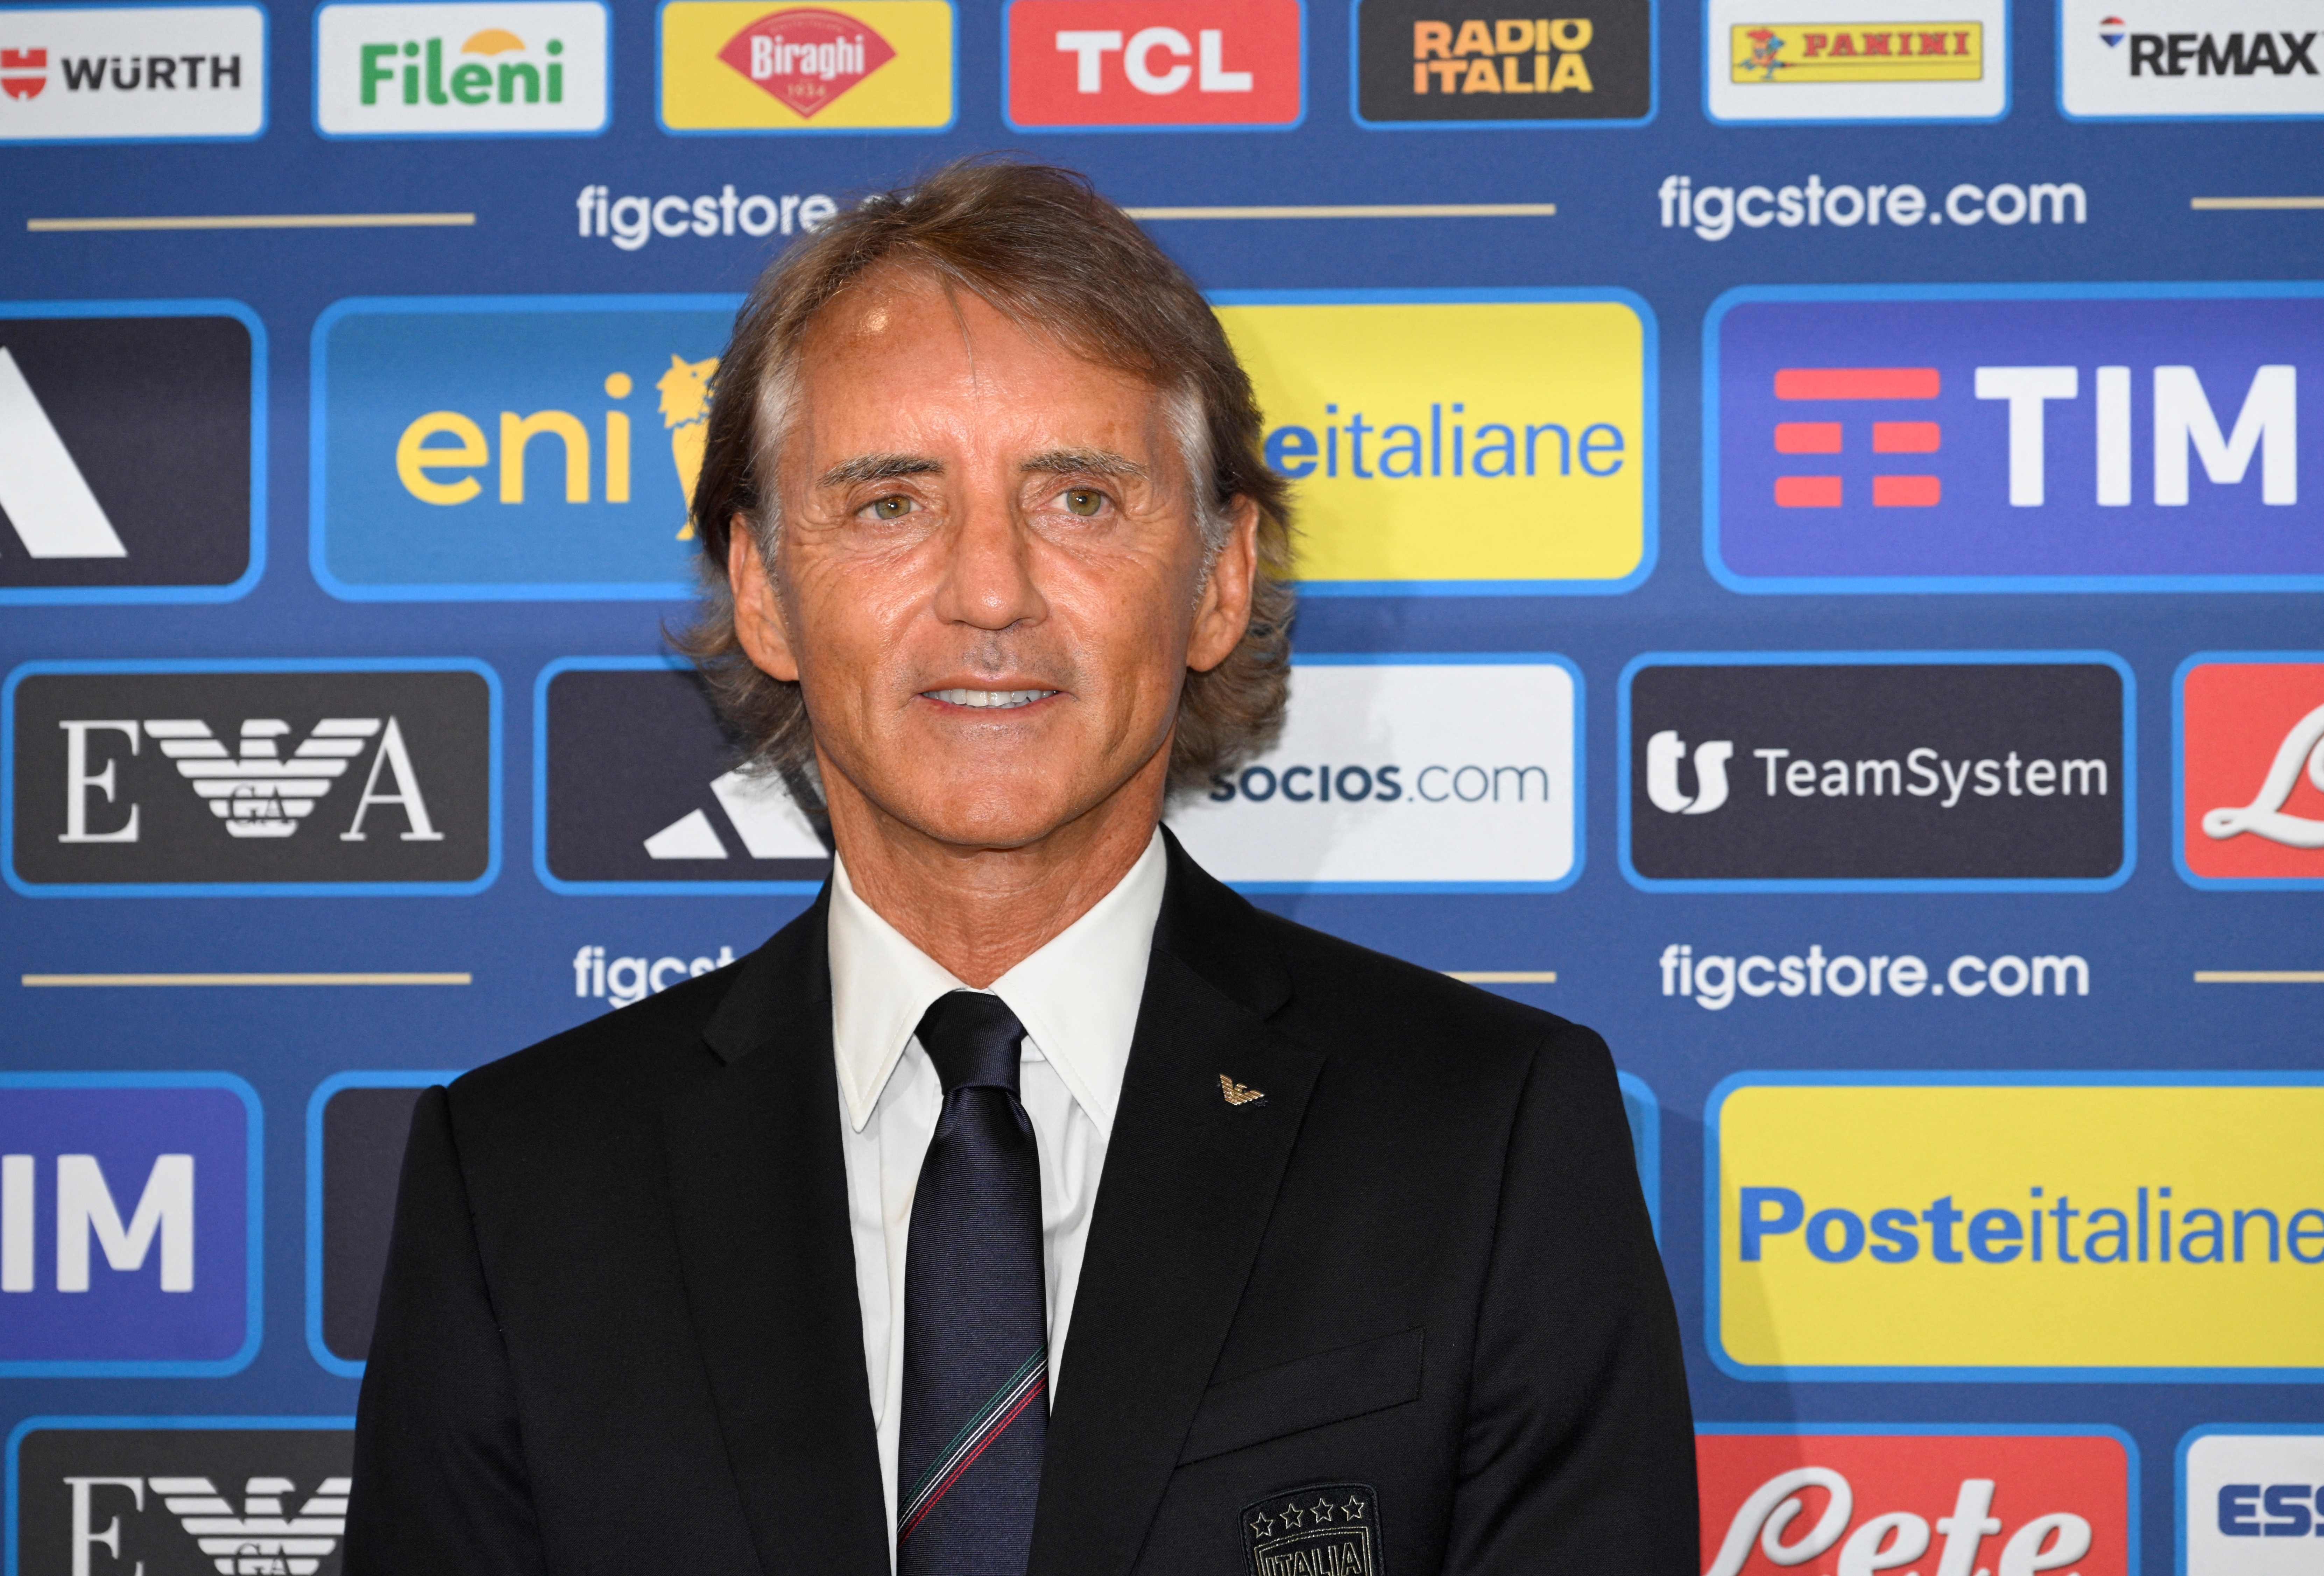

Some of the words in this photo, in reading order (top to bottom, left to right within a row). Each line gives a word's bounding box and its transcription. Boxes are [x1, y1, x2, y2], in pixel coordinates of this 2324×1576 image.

[750, 34, 865, 80] Biraghi
[1056, 27, 1253, 95] TCL
[1413, 18, 1594, 59] RADIO
[1802, 31, 1970, 57] PANINI
[61, 55, 241, 92] WÜRTH
[360, 38, 564, 106] Fileni
[1413, 52, 1594, 94] ITALIA
[1659, 176, 2088, 241] figcstore.com
[395, 371, 633, 506] eni
[1974, 364, 2298, 507] TIM
[1753, 747, 2108, 808] TeamSystem
[1660, 944, 2090, 1011] figcstore.com
[2217, 1484, 2324, 1537] ES
[1265, 1542, 1362, 1576] ITALIA
